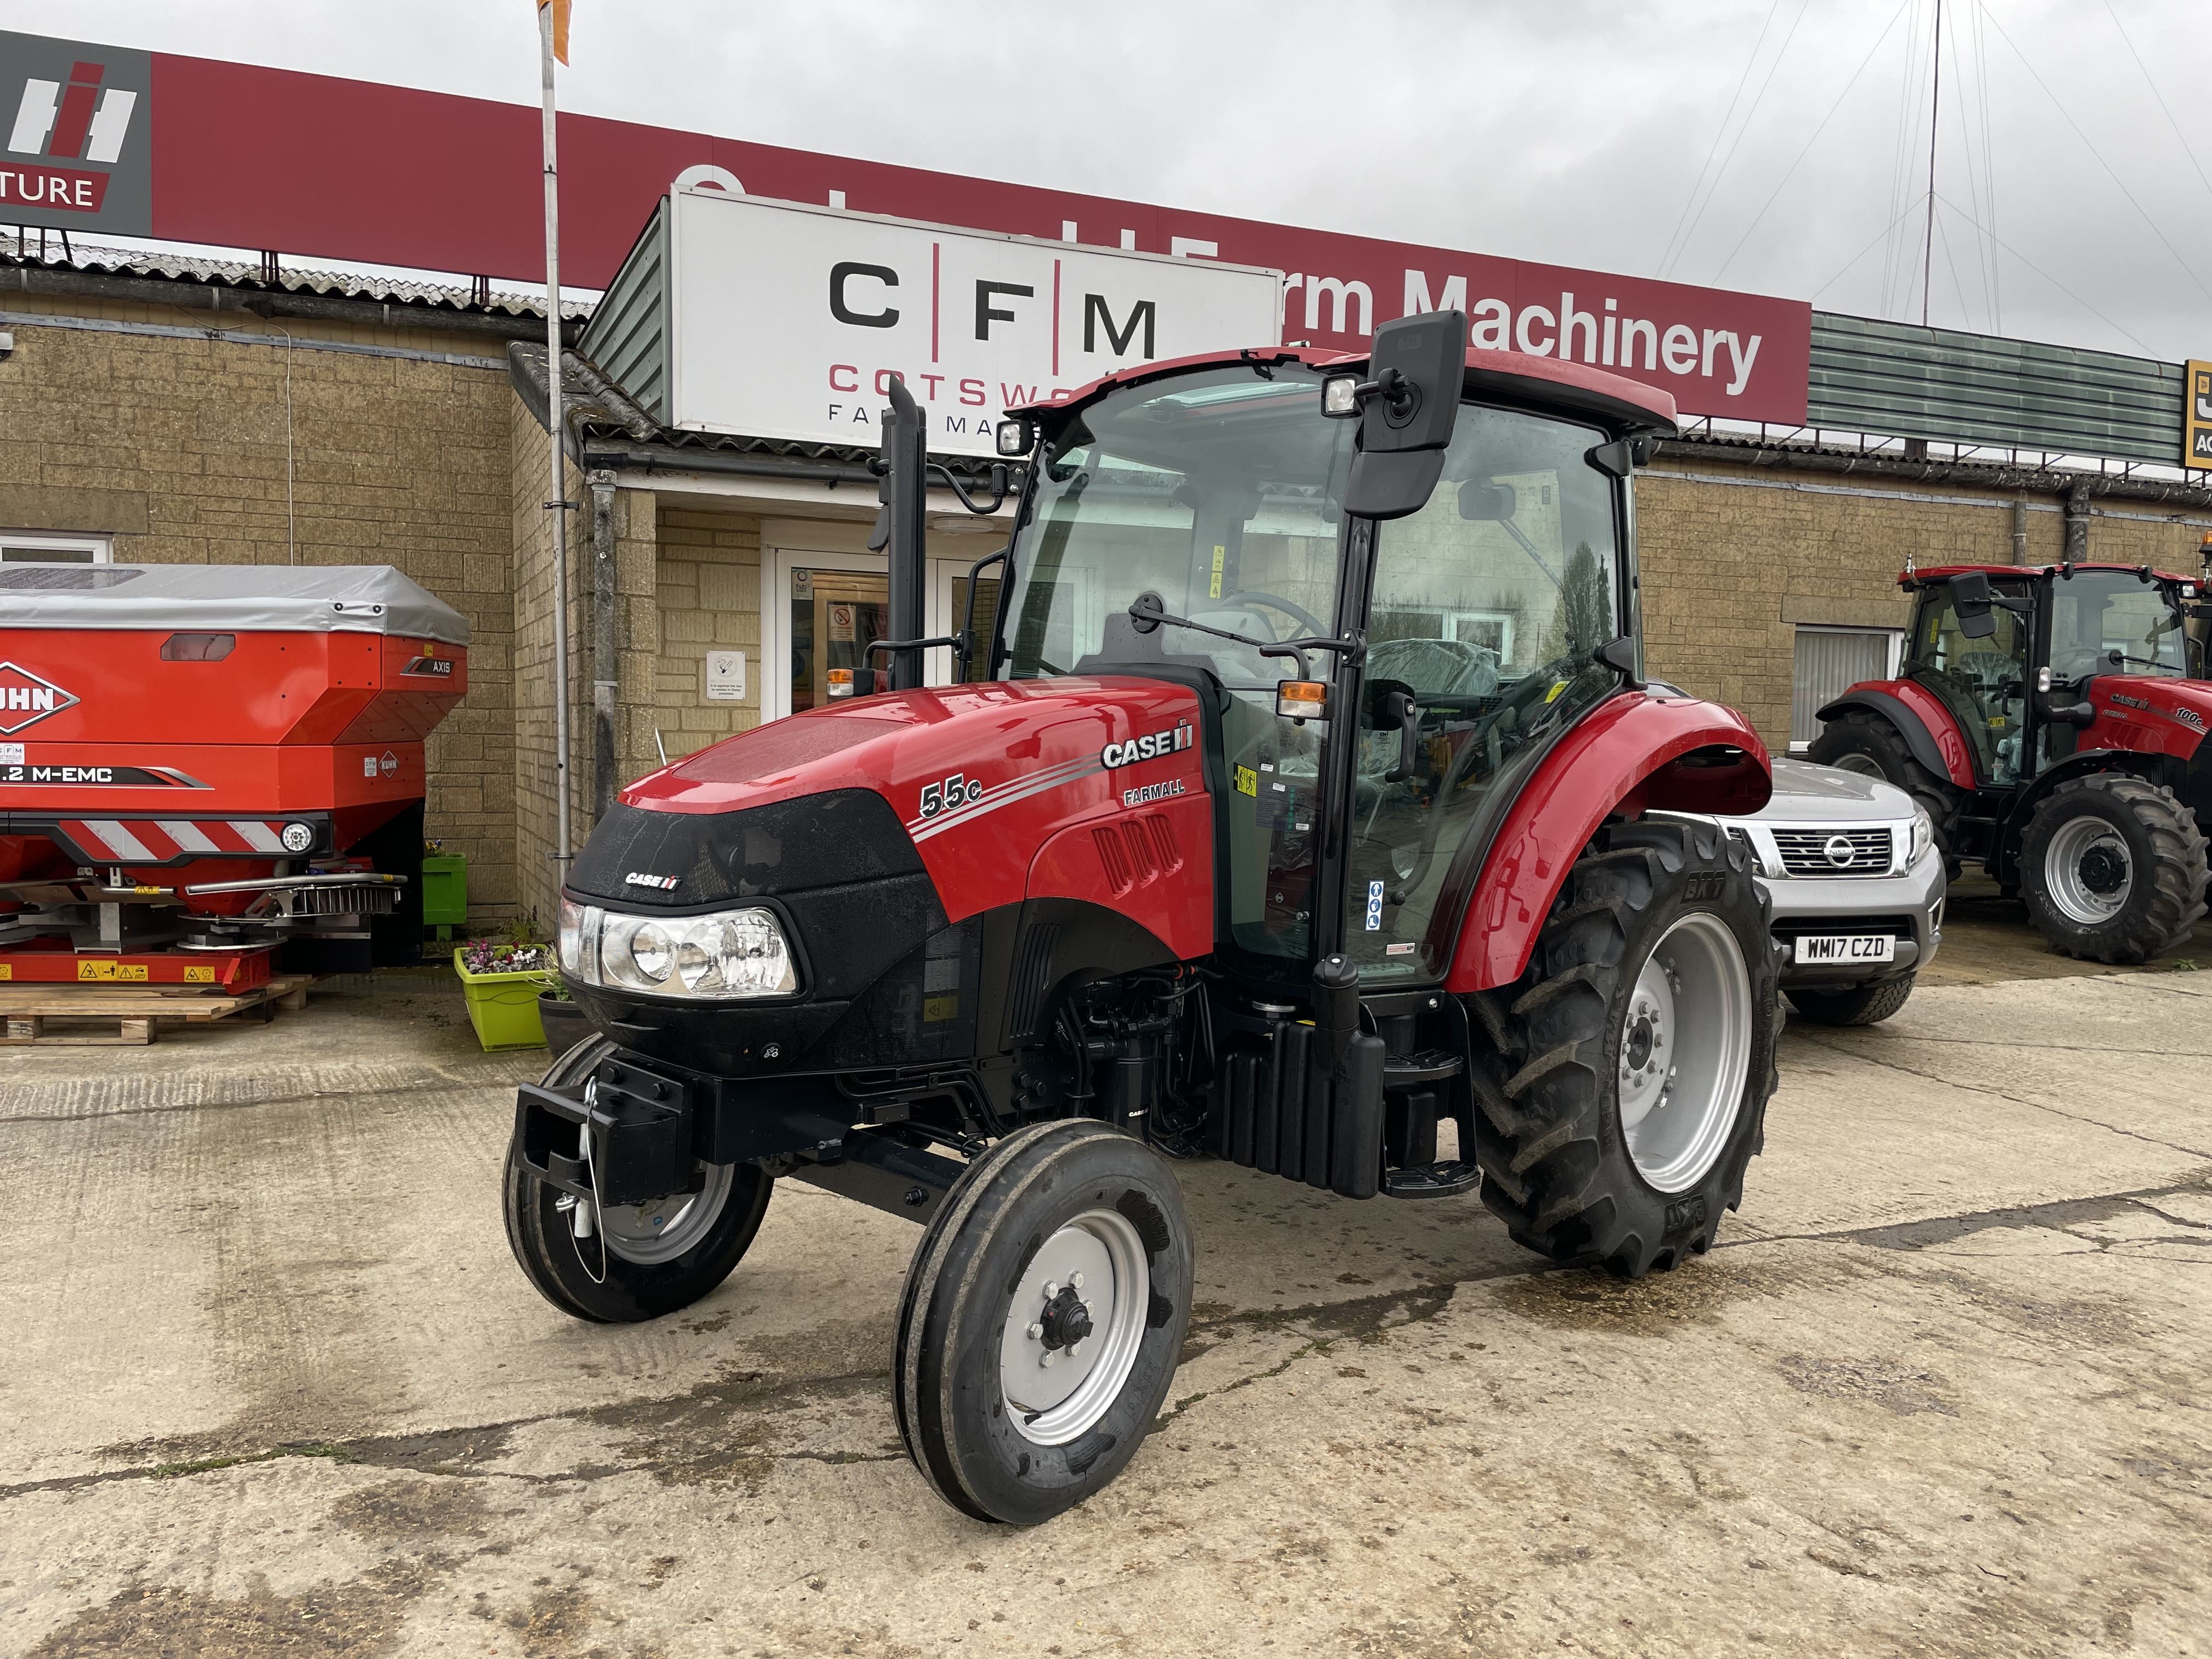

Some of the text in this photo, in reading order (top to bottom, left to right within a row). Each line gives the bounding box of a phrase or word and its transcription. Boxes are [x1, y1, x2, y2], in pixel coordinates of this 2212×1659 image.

[0, 171, 93, 206] TURE
[1403, 269, 1762, 396] Machinery
[829, 404, 885, 425] FA
[433, 661, 450, 673] AXIS
[0, 688, 54, 710] HN
[2111, 694, 2137, 707] CASE
[1103, 731, 1171, 769] CASE
[33, 767, 112, 782] M-EMC
[381, 760, 397, 770] KUHN
[919, 773, 982, 819] 55c
[1124, 779, 1184, 806] FARMALL
[625, 872, 662, 887] CASE
[1684, 878, 1725, 899] BKT
[1808, 938, 1884, 958] WM17 CZD
